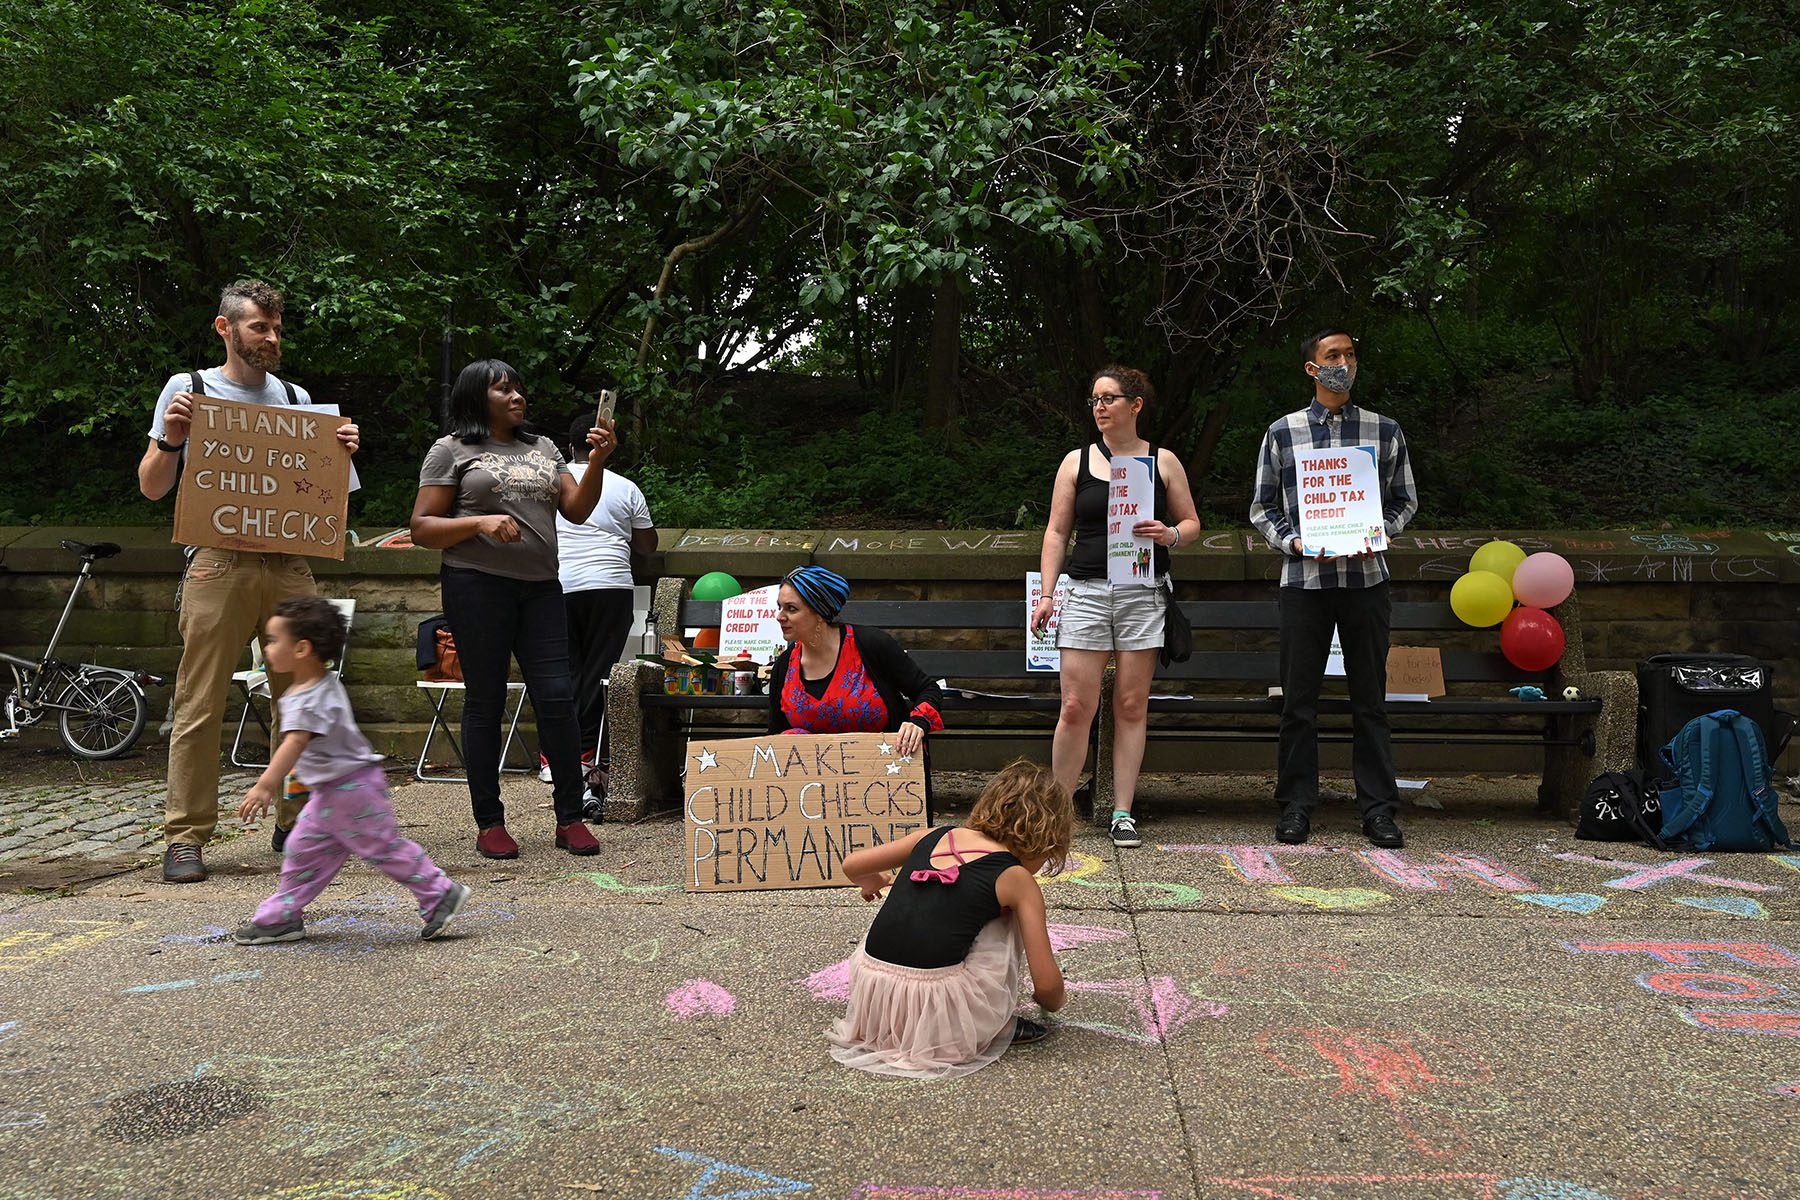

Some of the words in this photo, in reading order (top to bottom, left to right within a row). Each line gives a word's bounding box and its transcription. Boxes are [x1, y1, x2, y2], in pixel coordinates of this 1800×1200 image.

[199, 403, 319, 440] THANK
[202, 439, 254, 464] YOU
[266, 449, 308, 471] FOR
[1302, 457, 1348, 471] THANKS
[195, 470, 278, 495] CHILD
[1302, 475, 1325, 489] FOR
[1329, 474, 1352, 487] THE
[1304, 492, 1336, 504] CHILD
[1340, 490, 1365, 502] TAX
[1119, 503, 1138, 515] TAX
[1305, 507, 1346, 520] CREDIT
[211, 504, 338, 546] CHECKS
[828, 537, 928, 552] MORE
[938, 533, 1029, 550] WE
[1390, 536, 1552, 551] CHECS
[727, 597, 746, 605] FOR
[750, 597, 768, 605] THE
[727, 609, 753, 618] CHILD
[757, 609, 776, 618] TAX
[726, 623, 759, 632] CREDIT
[748, 741, 861, 778] MAKE
[687, 785, 788, 825] CHILD
[800, 781, 924, 820] CHECKS
